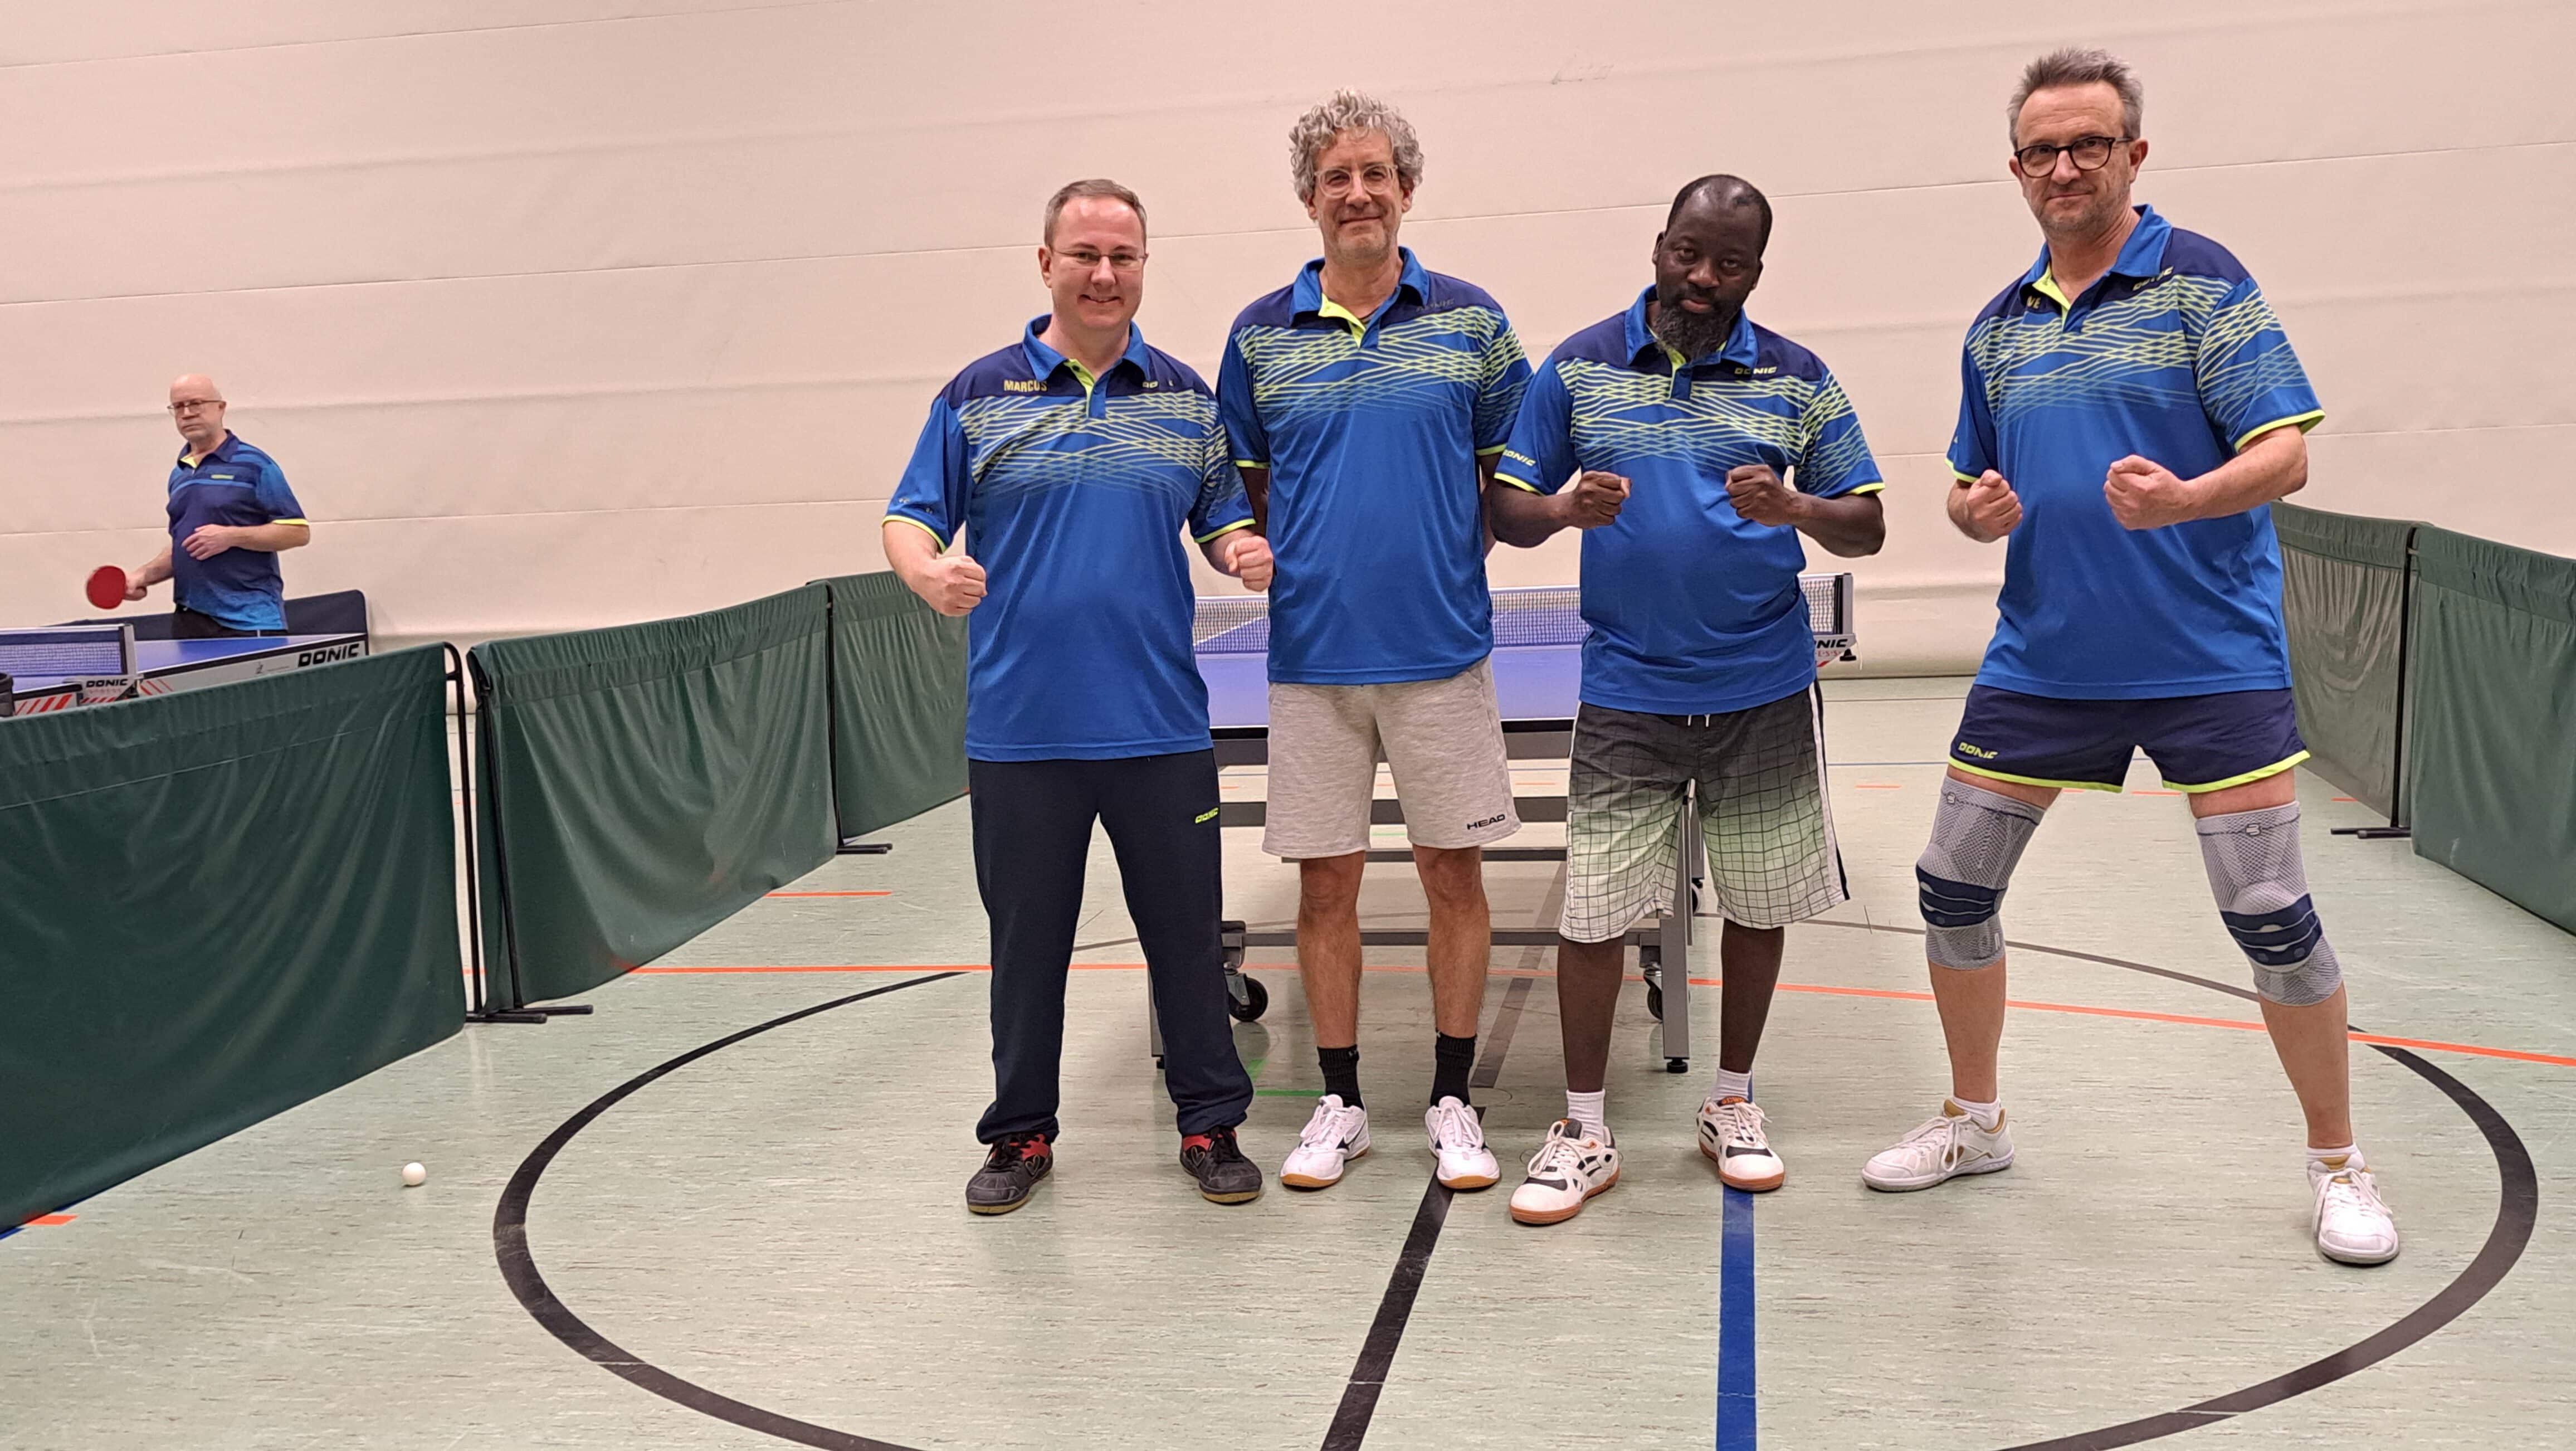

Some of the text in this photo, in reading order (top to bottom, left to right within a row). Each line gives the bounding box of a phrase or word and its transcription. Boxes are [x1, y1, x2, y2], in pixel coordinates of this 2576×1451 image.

[2133, 266, 2174, 291] DOIC
[1004, 379, 1047, 392] MARCUS
[1814, 639, 1848, 649] NIC
[298, 643, 360, 668] DONIC
[86, 679, 128, 688] DONIC
[1958, 742, 1998, 759] DONIC
[1466, 814, 1505, 830] HEAD
